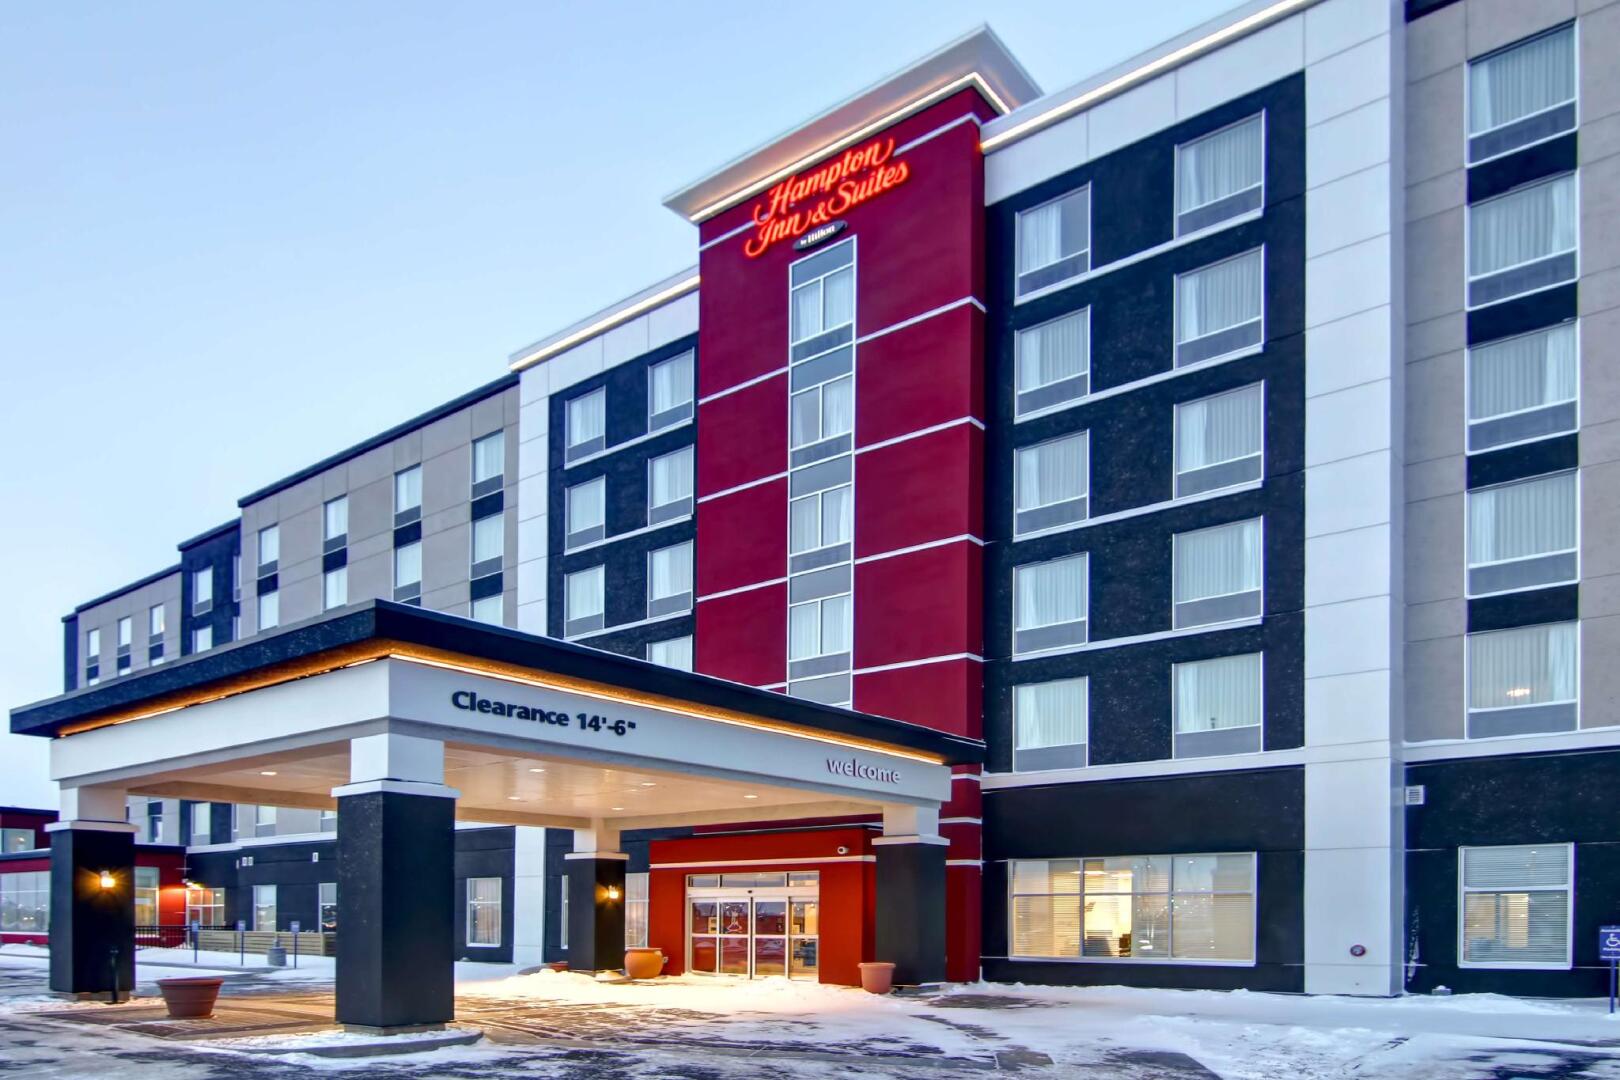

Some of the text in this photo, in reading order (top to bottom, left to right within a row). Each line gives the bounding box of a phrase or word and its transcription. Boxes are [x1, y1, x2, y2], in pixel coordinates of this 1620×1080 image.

[753, 137, 894, 225] Hampton
[745, 160, 909, 257] Inn & Suites
[807, 224, 835, 243] Hilton
[451, 690, 570, 727] Clearance
[826, 758, 901, 784] welcome
